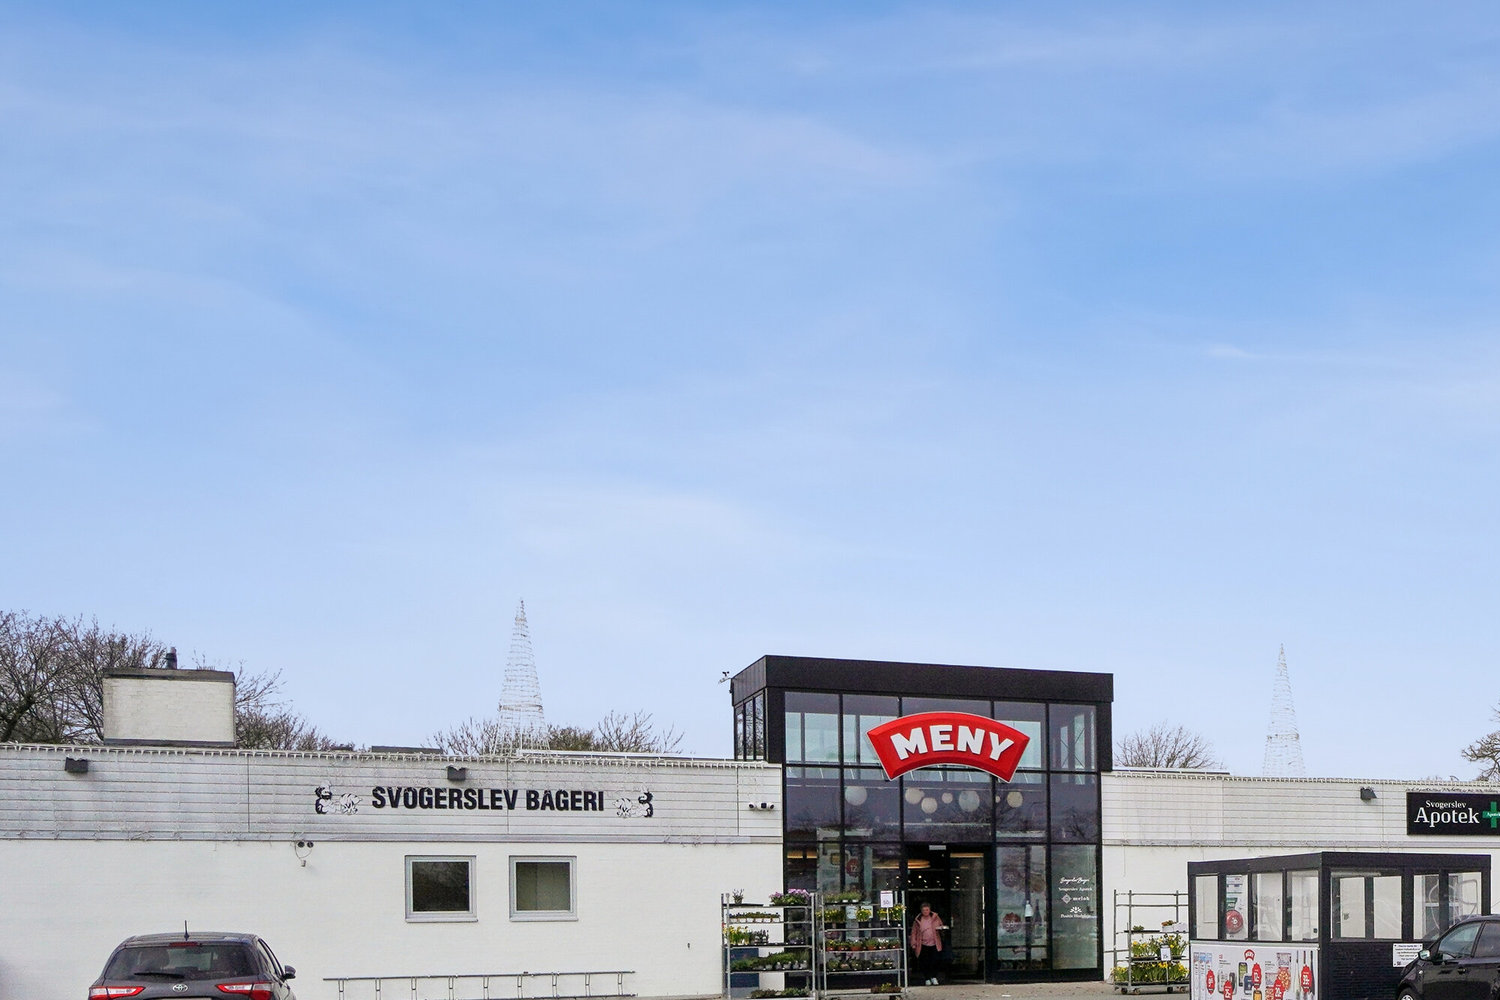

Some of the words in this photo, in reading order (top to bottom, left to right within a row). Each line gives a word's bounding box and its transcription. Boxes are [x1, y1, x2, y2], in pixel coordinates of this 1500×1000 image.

[890, 724, 1015, 761] MENY
[372, 786, 518, 810] SVOGERSLEV
[526, 788, 604, 811] BAGERI
[1425, 800, 1467, 809] Svogerslev
[1414, 807, 1480, 828] Apotek
